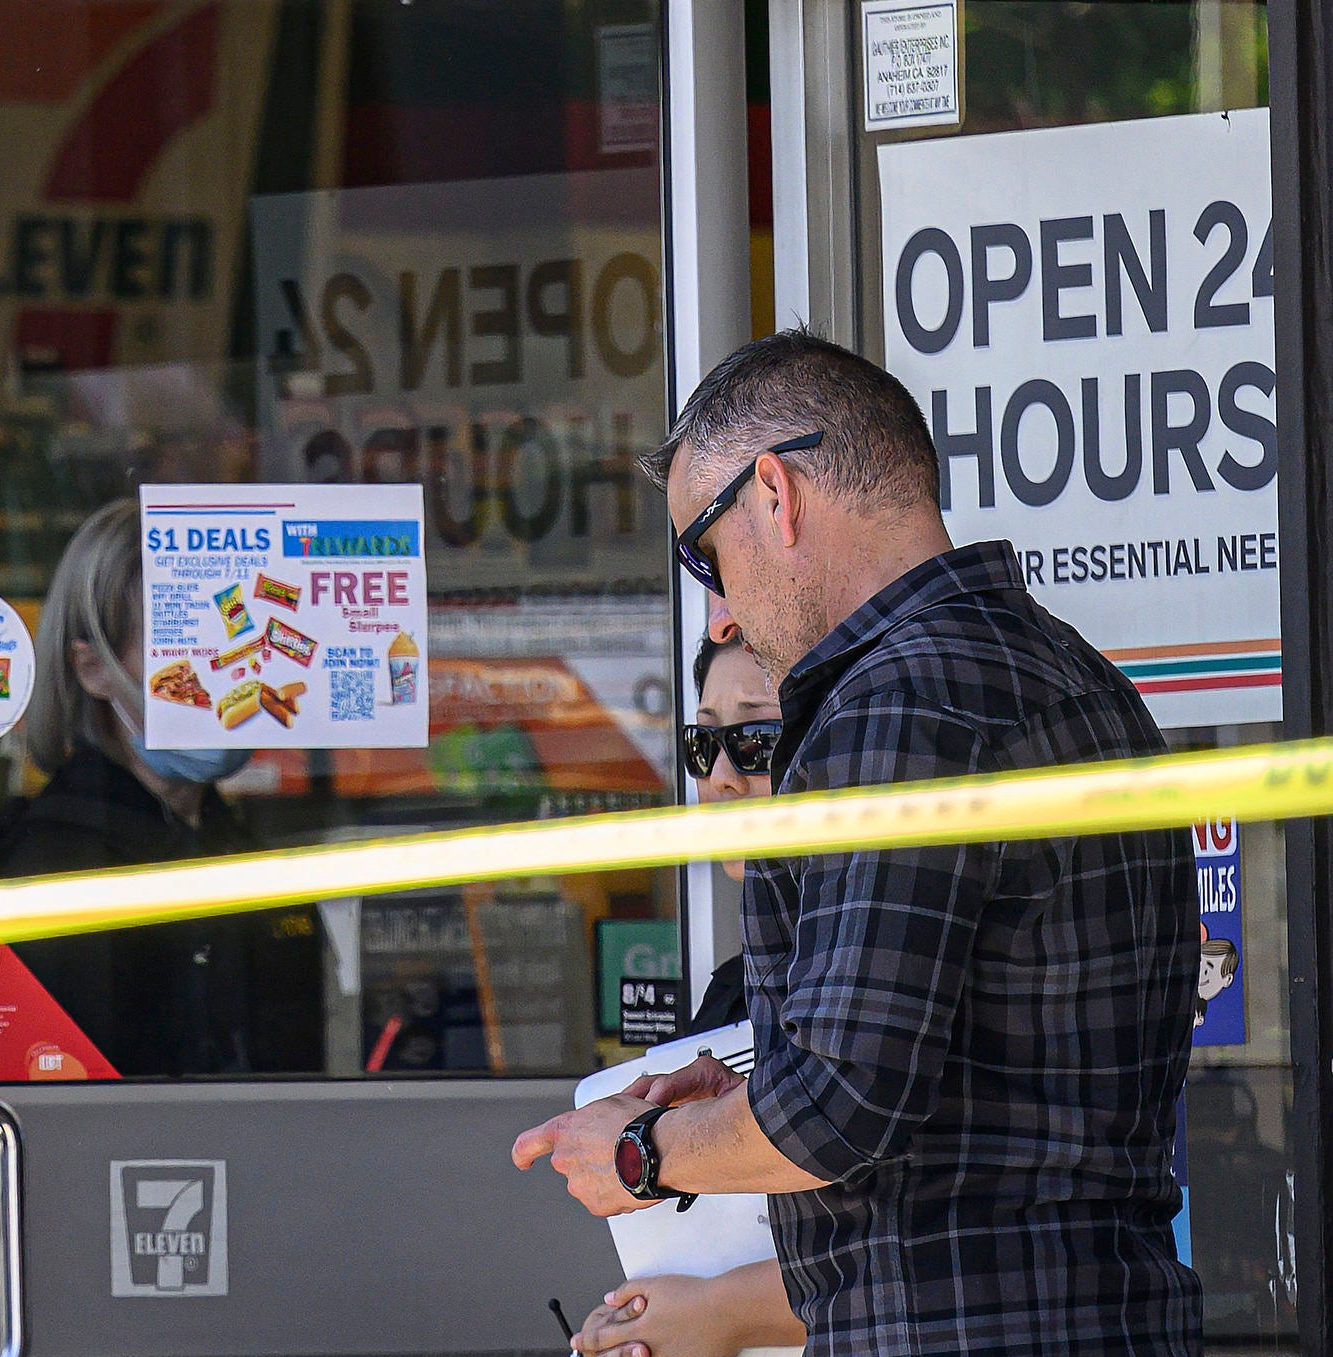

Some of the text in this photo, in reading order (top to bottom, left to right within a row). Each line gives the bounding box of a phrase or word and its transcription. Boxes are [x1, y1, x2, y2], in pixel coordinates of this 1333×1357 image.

[895, 209, 1169, 354] OPEN
[932, 361, 1278, 513] HOURS
[286, 522, 319, 537] WITH
[147, 526, 271, 553] $1 DEALS
[178, 555, 231, 568] EXCLUSIVE
[235, 556, 269, 568] DEALS
[1053, 537, 1211, 584] ESSENTIAL
[172, 568, 221, 579] THROUGH
[310, 571, 410, 606] FREE
[342, 607, 379, 619] Small
[348, 621, 400, 635] Slurpee
[161, 648, 189, 657] MANY
[192, 647, 220, 656] MORE
[327, 647, 374, 658] SCAN TO
[323, 659, 347, 668] JOIN
